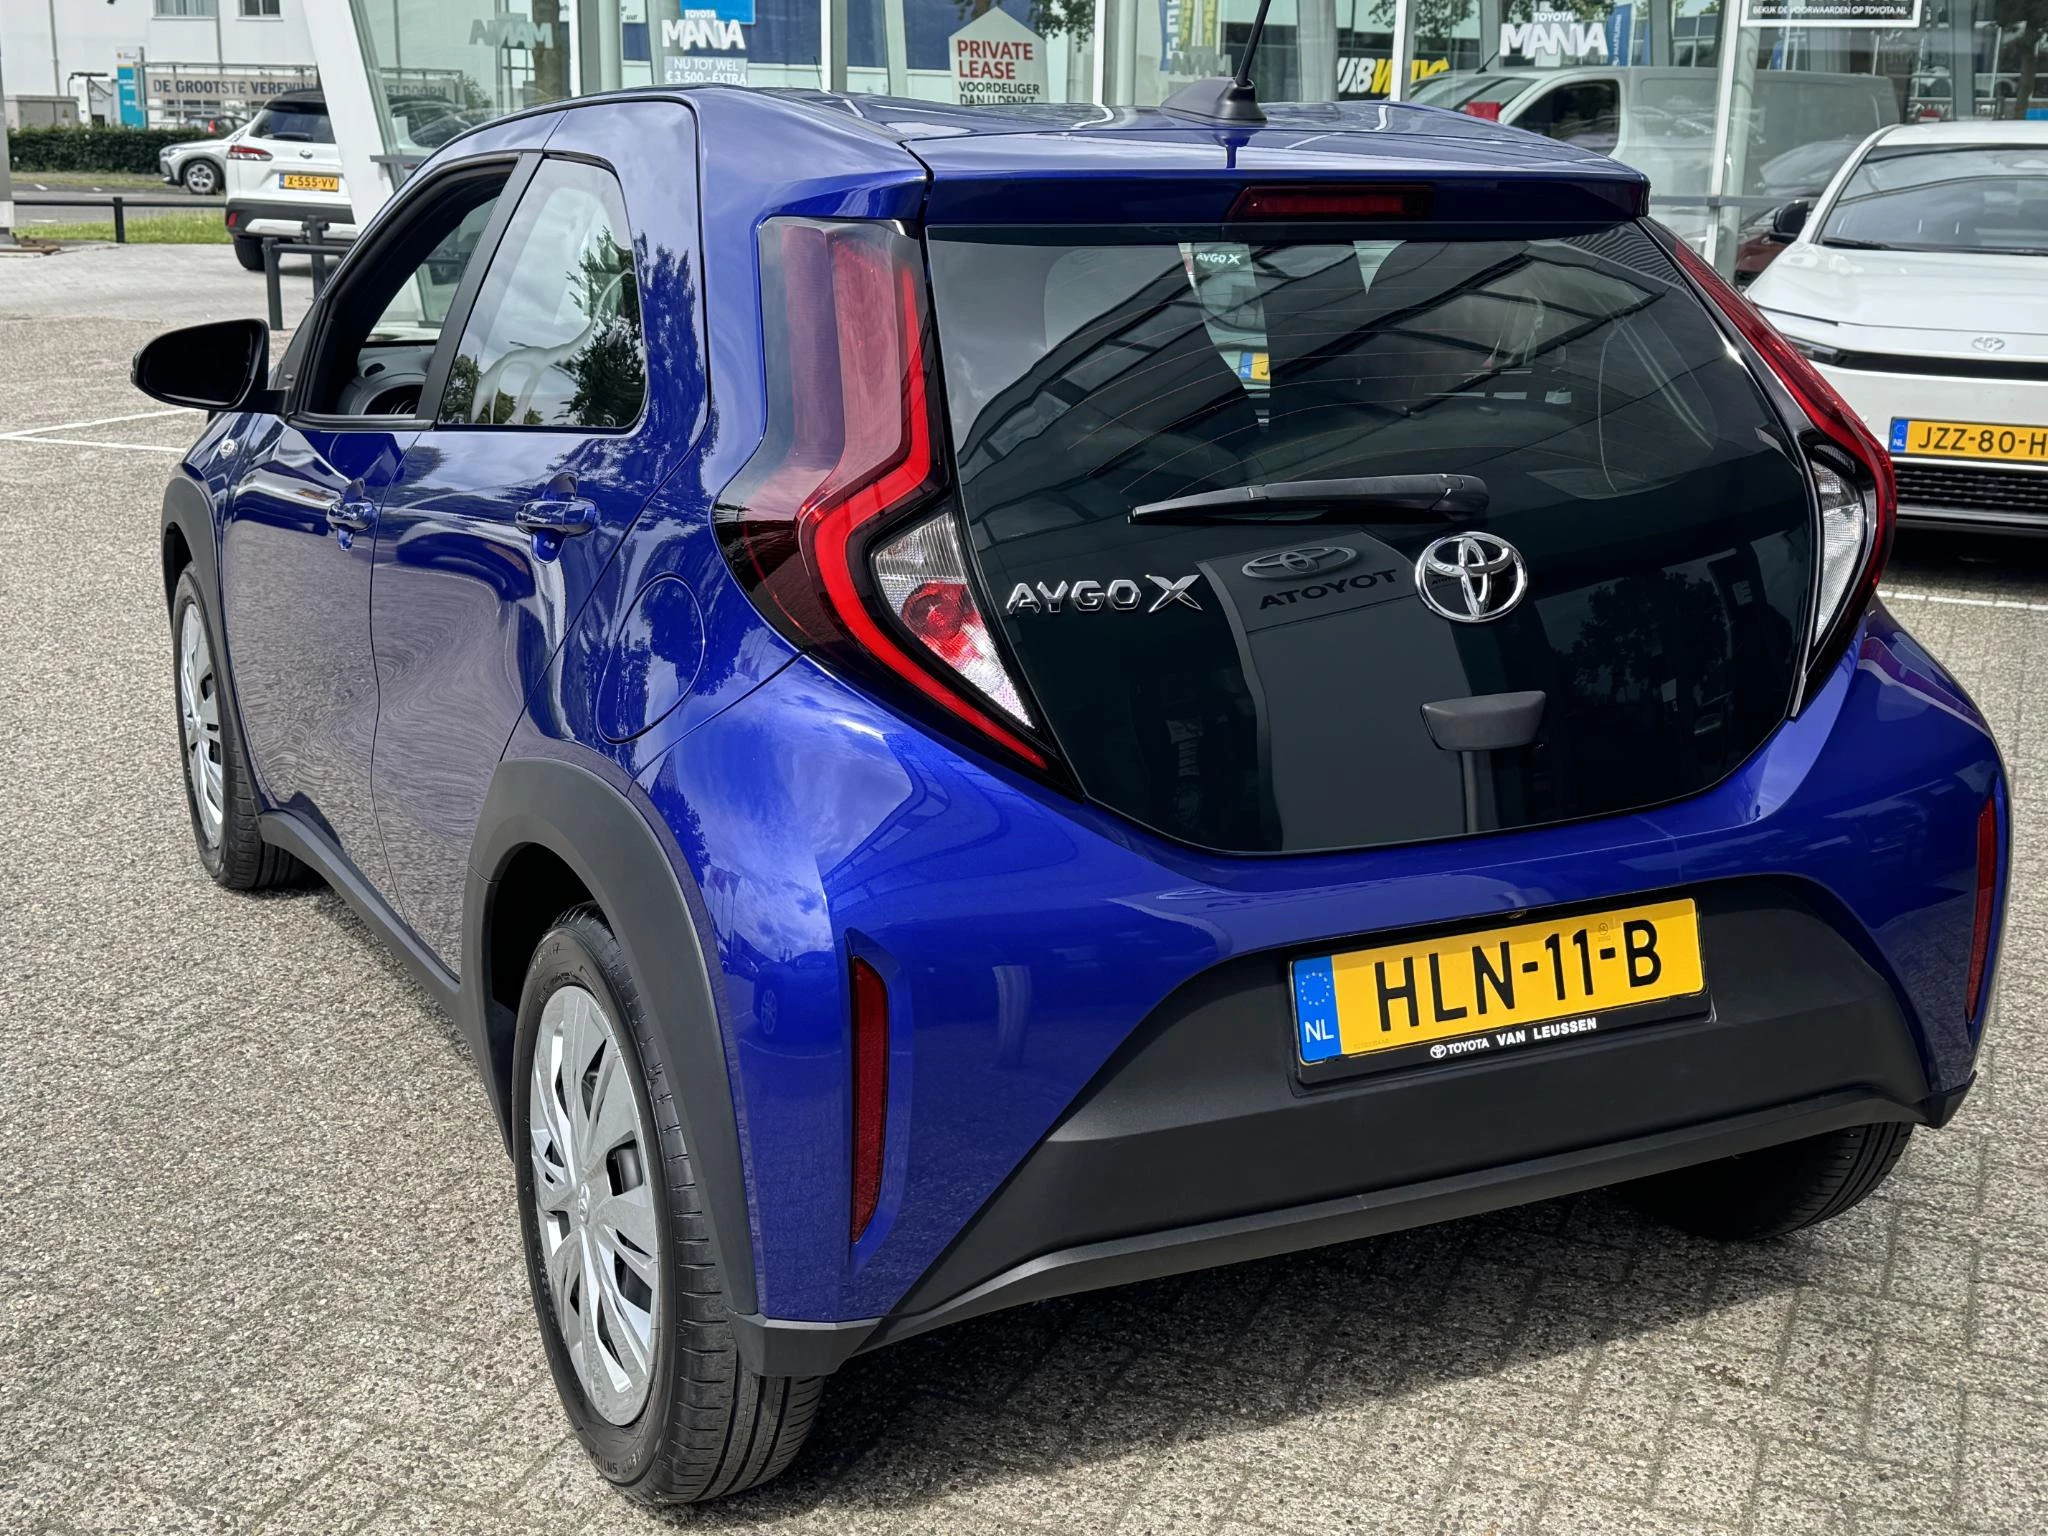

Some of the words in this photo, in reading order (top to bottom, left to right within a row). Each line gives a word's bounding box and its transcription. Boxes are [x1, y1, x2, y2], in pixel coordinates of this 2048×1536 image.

[684, 9, 717, 19] TOYOTA
[1533, 11, 1575, 22] TOYOTA
[660, 19, 746, 50] MANIA
[1499, 22, 1609, 59] MANIA
[957, 39, 1034, 60] PRIVATE
[674, 57, 691, 69] NU
[694, 58, 713, 70] TOT
[715, 60, 739, 72] WEL
[958, 59, 1016, 80] LEASE
[153, 79, 171, 93] DE
[176, 79, 246, 95] GROOTSTE
[958, 81, 1041, 95] VOORDELIGER
[1892, 439, 1905, 447] NL
[1917, 426, 2048, 456] JZZ-80-H
[1006, 578, 1142, 614] AYGO
[1144, 573, 1203, 613] X
[1373, 918, 1663, 1033] HLN-11-B
[1305, 1018, 1335, 1044] NL
[1446, 1037, 1490, 1055] TOYOTA
[1495, 1029, 1527, 1047] VAN
[1532, 1016, 1598, 1041] LEUSSEN
